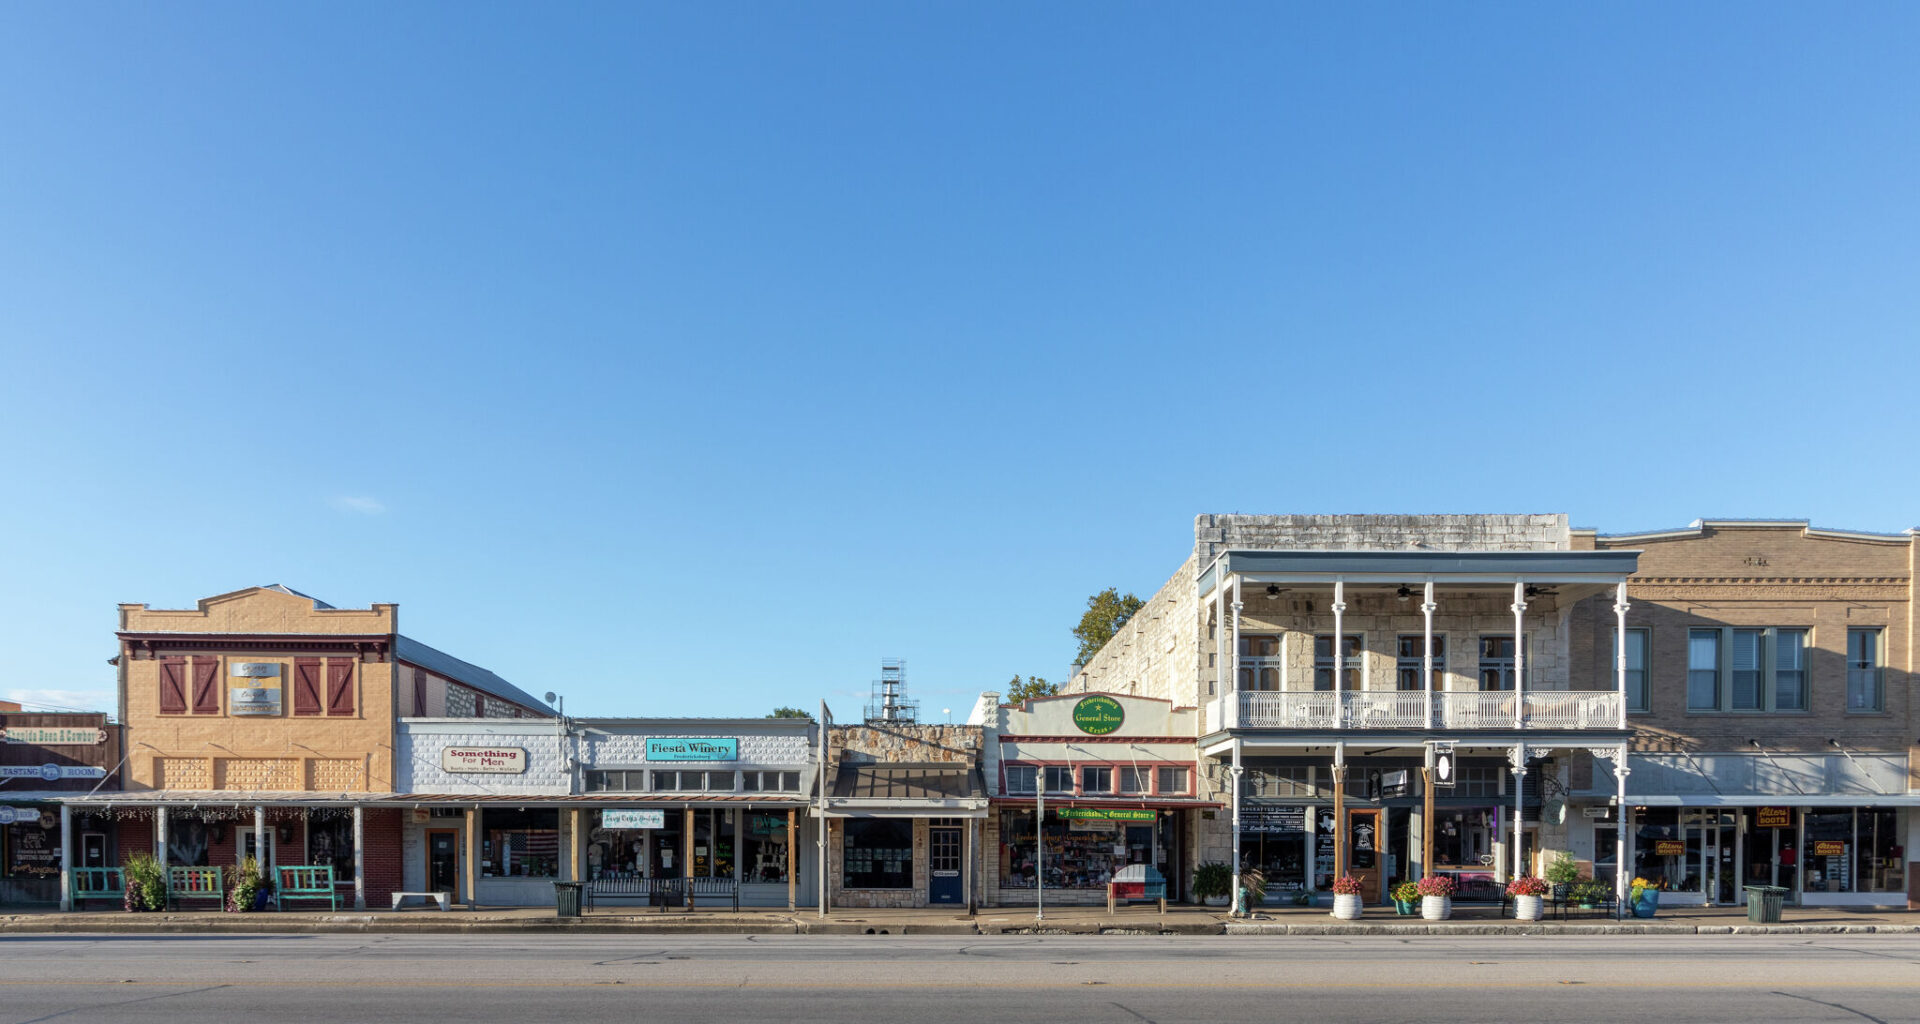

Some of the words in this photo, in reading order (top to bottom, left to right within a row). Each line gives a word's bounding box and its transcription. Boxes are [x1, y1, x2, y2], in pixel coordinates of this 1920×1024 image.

[1076, 712, 1102, 722] General
[1103, 713, 1121, 722] Store
[1088, 726, 1108, 734] Texas
[67, 729, 96, 743] Cowboy
[651, 743, 686, 753] Fiesta
[688, 743, 731, 754] Winery
[450, 749, 517, 759] Something
[480, 757, 505, 766] Men
[2, 767, 39, 776] TASTING
[67, 768, 96, 776] ROOM
[1064, 809, 1108, 819] Fredericksburg
[1108, 810, 1132, 819] General
[1132, 811, 1150, 819] Store
